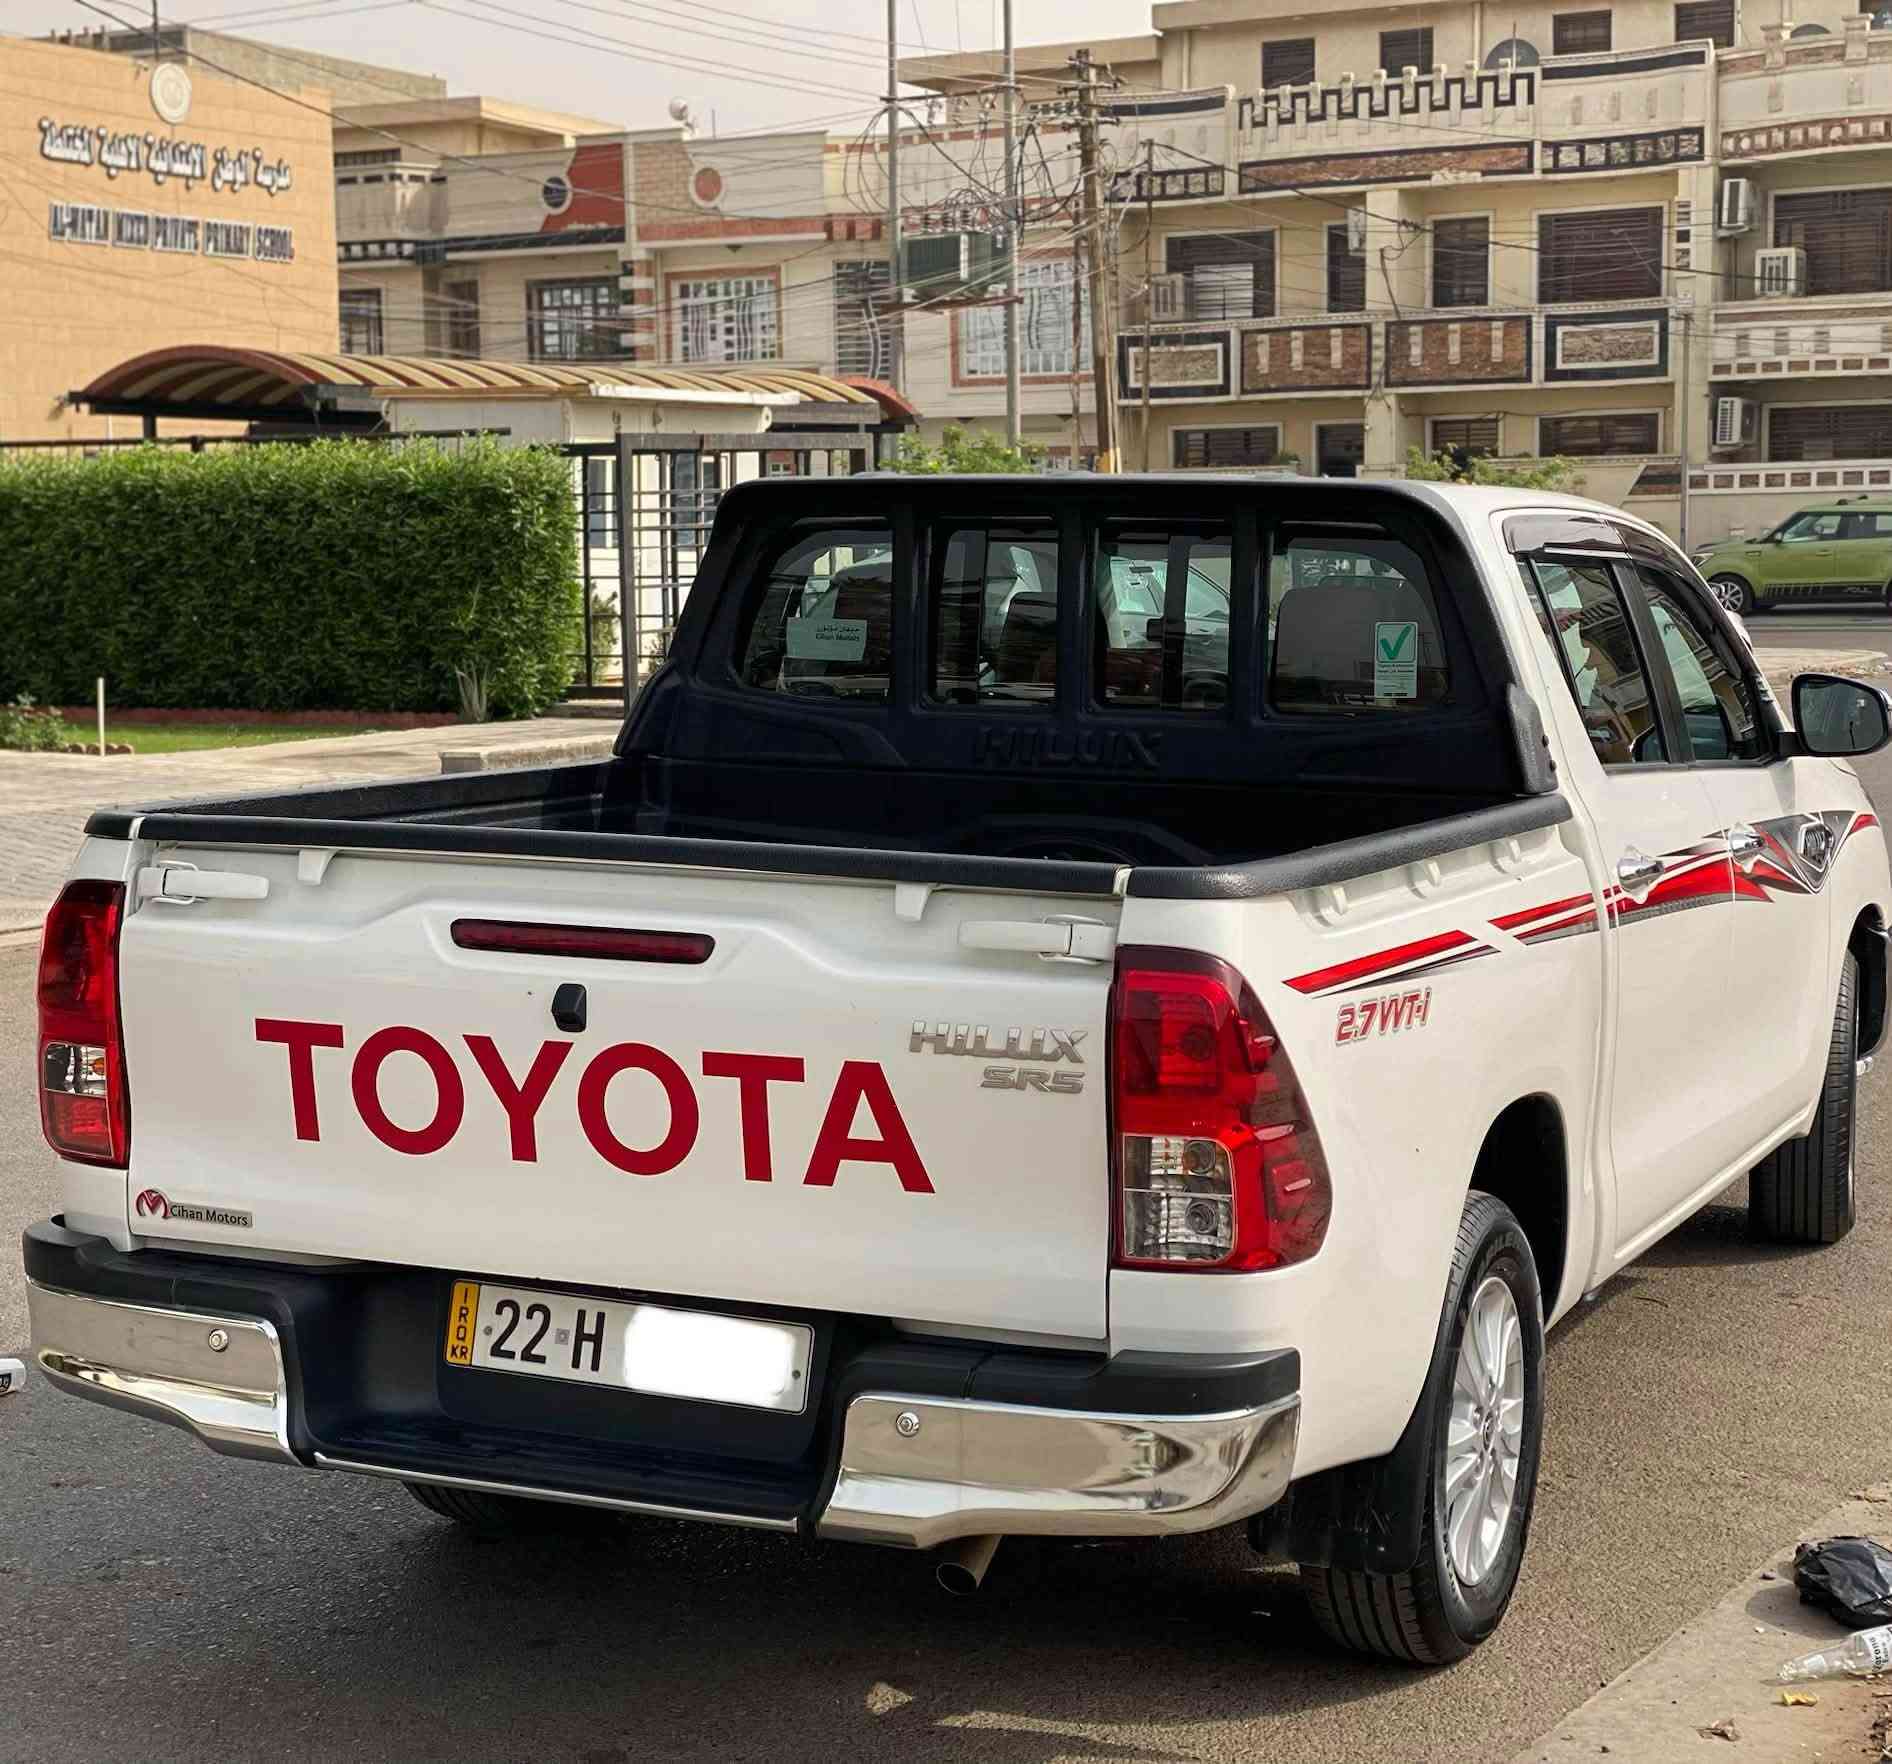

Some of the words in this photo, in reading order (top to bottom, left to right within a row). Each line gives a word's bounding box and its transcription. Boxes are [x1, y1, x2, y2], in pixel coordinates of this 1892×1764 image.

[254, 225, 295, 264] SCHOOL
[974, 725, 1163, 768] HILUX
[909, 1020, 1088, 1064] HILUX
[255, 1018, 936, 1195] TOYOTA
[170, 1204, 203, 1221] Cihan
[205, 1209, 249, 1226] Motors
[450, 1344, 469, 1361] KR
[489, 1299, 552, 1365] 22
[572, 1309, 606, 1372] H
